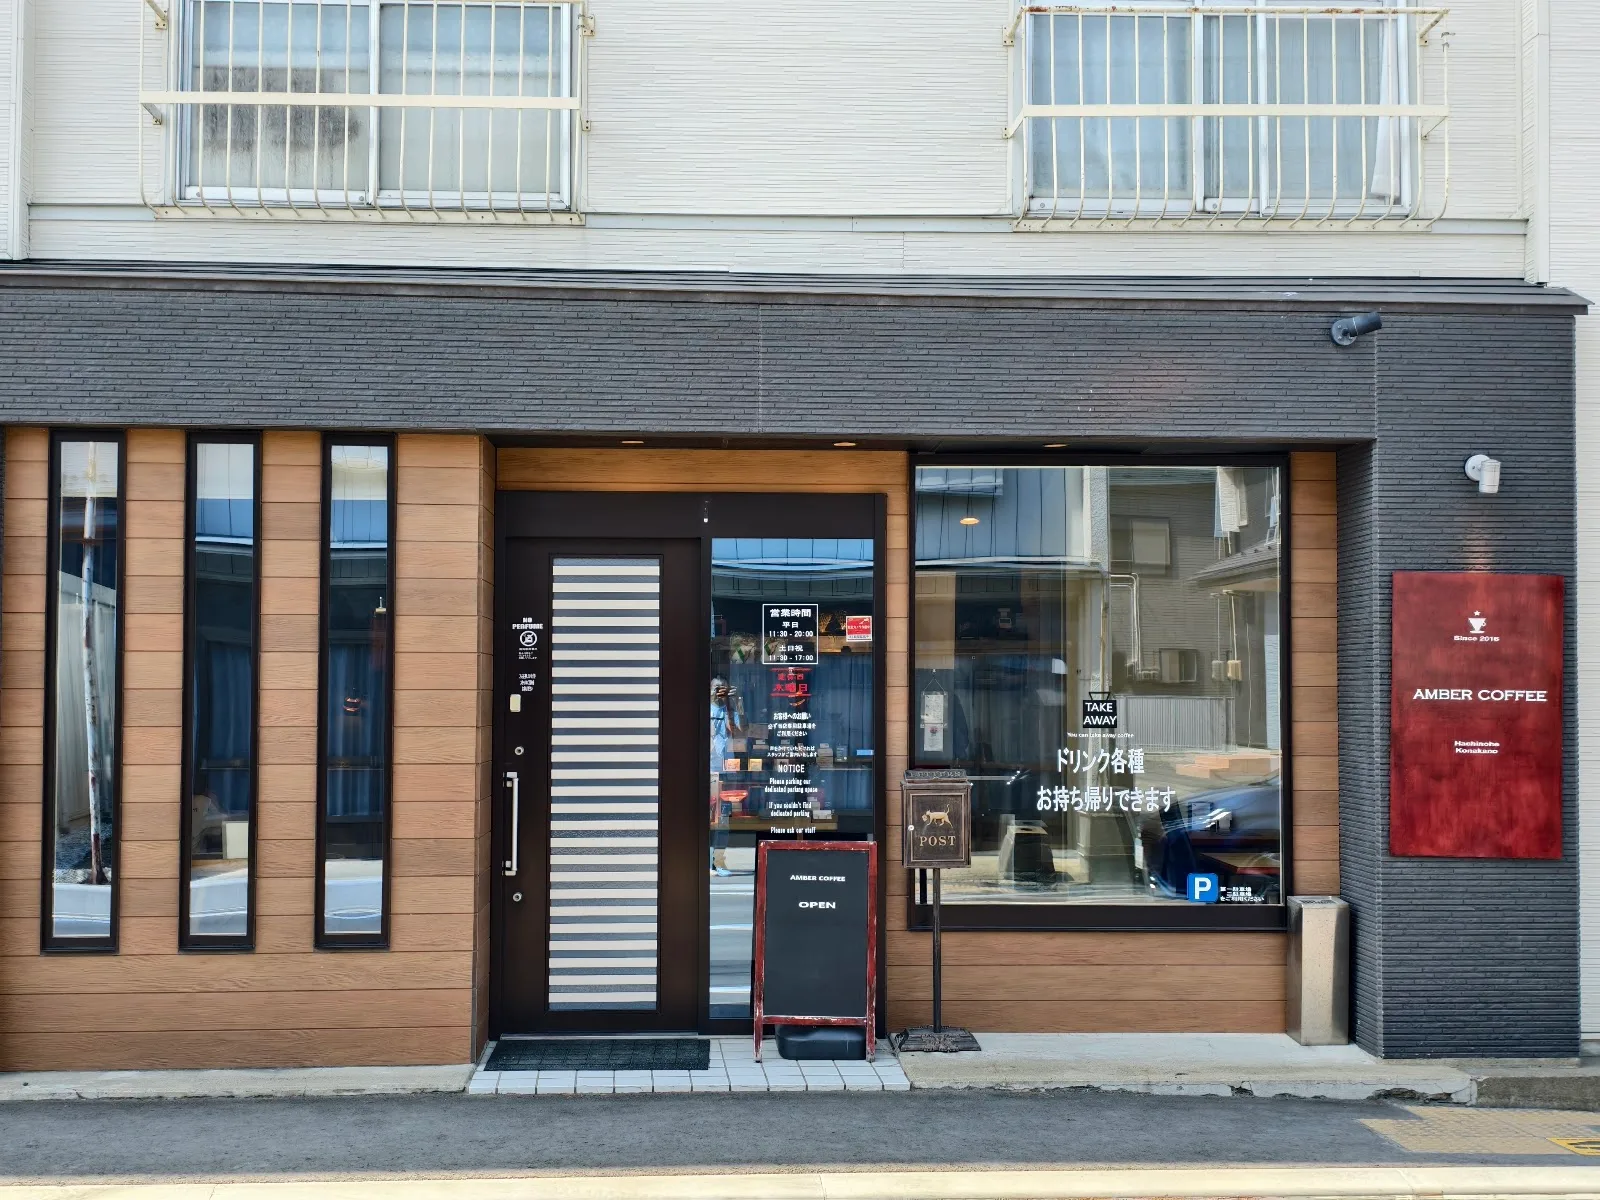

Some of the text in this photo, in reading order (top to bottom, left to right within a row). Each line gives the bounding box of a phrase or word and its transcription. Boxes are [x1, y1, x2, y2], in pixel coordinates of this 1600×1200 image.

[769, 608, 812, 618] 営業時間
[782, 621, 799, 629] 平日
[779, 644, 804, 652] 土日祝
[1413, 689, 1548, 702] AMBER COFFEE
[1085, 702, 1113, 712] TAKE
[1083, 715, 1117, 725] AWAY
[1057, 747, 1145, 774] ドリンク各種
[777, 764, 805, 773] NOTICE
[769, 777, 785, 785] Please
[785, 777, 802, 786] parking
[787, 786, 804, 794] parking
[1036, 785, 1176, 812] お持ち帰りできます
[793, 810, 810, 818] parking
[770, 826, 786, 834] Please
[786, 826, 795, 834] ask
[804, 826, 816, 834] staff
[919, 835, 956, 847] POST
[1194, 877, 1212, 900] P
[798, 901, 836, 909] OPEN
